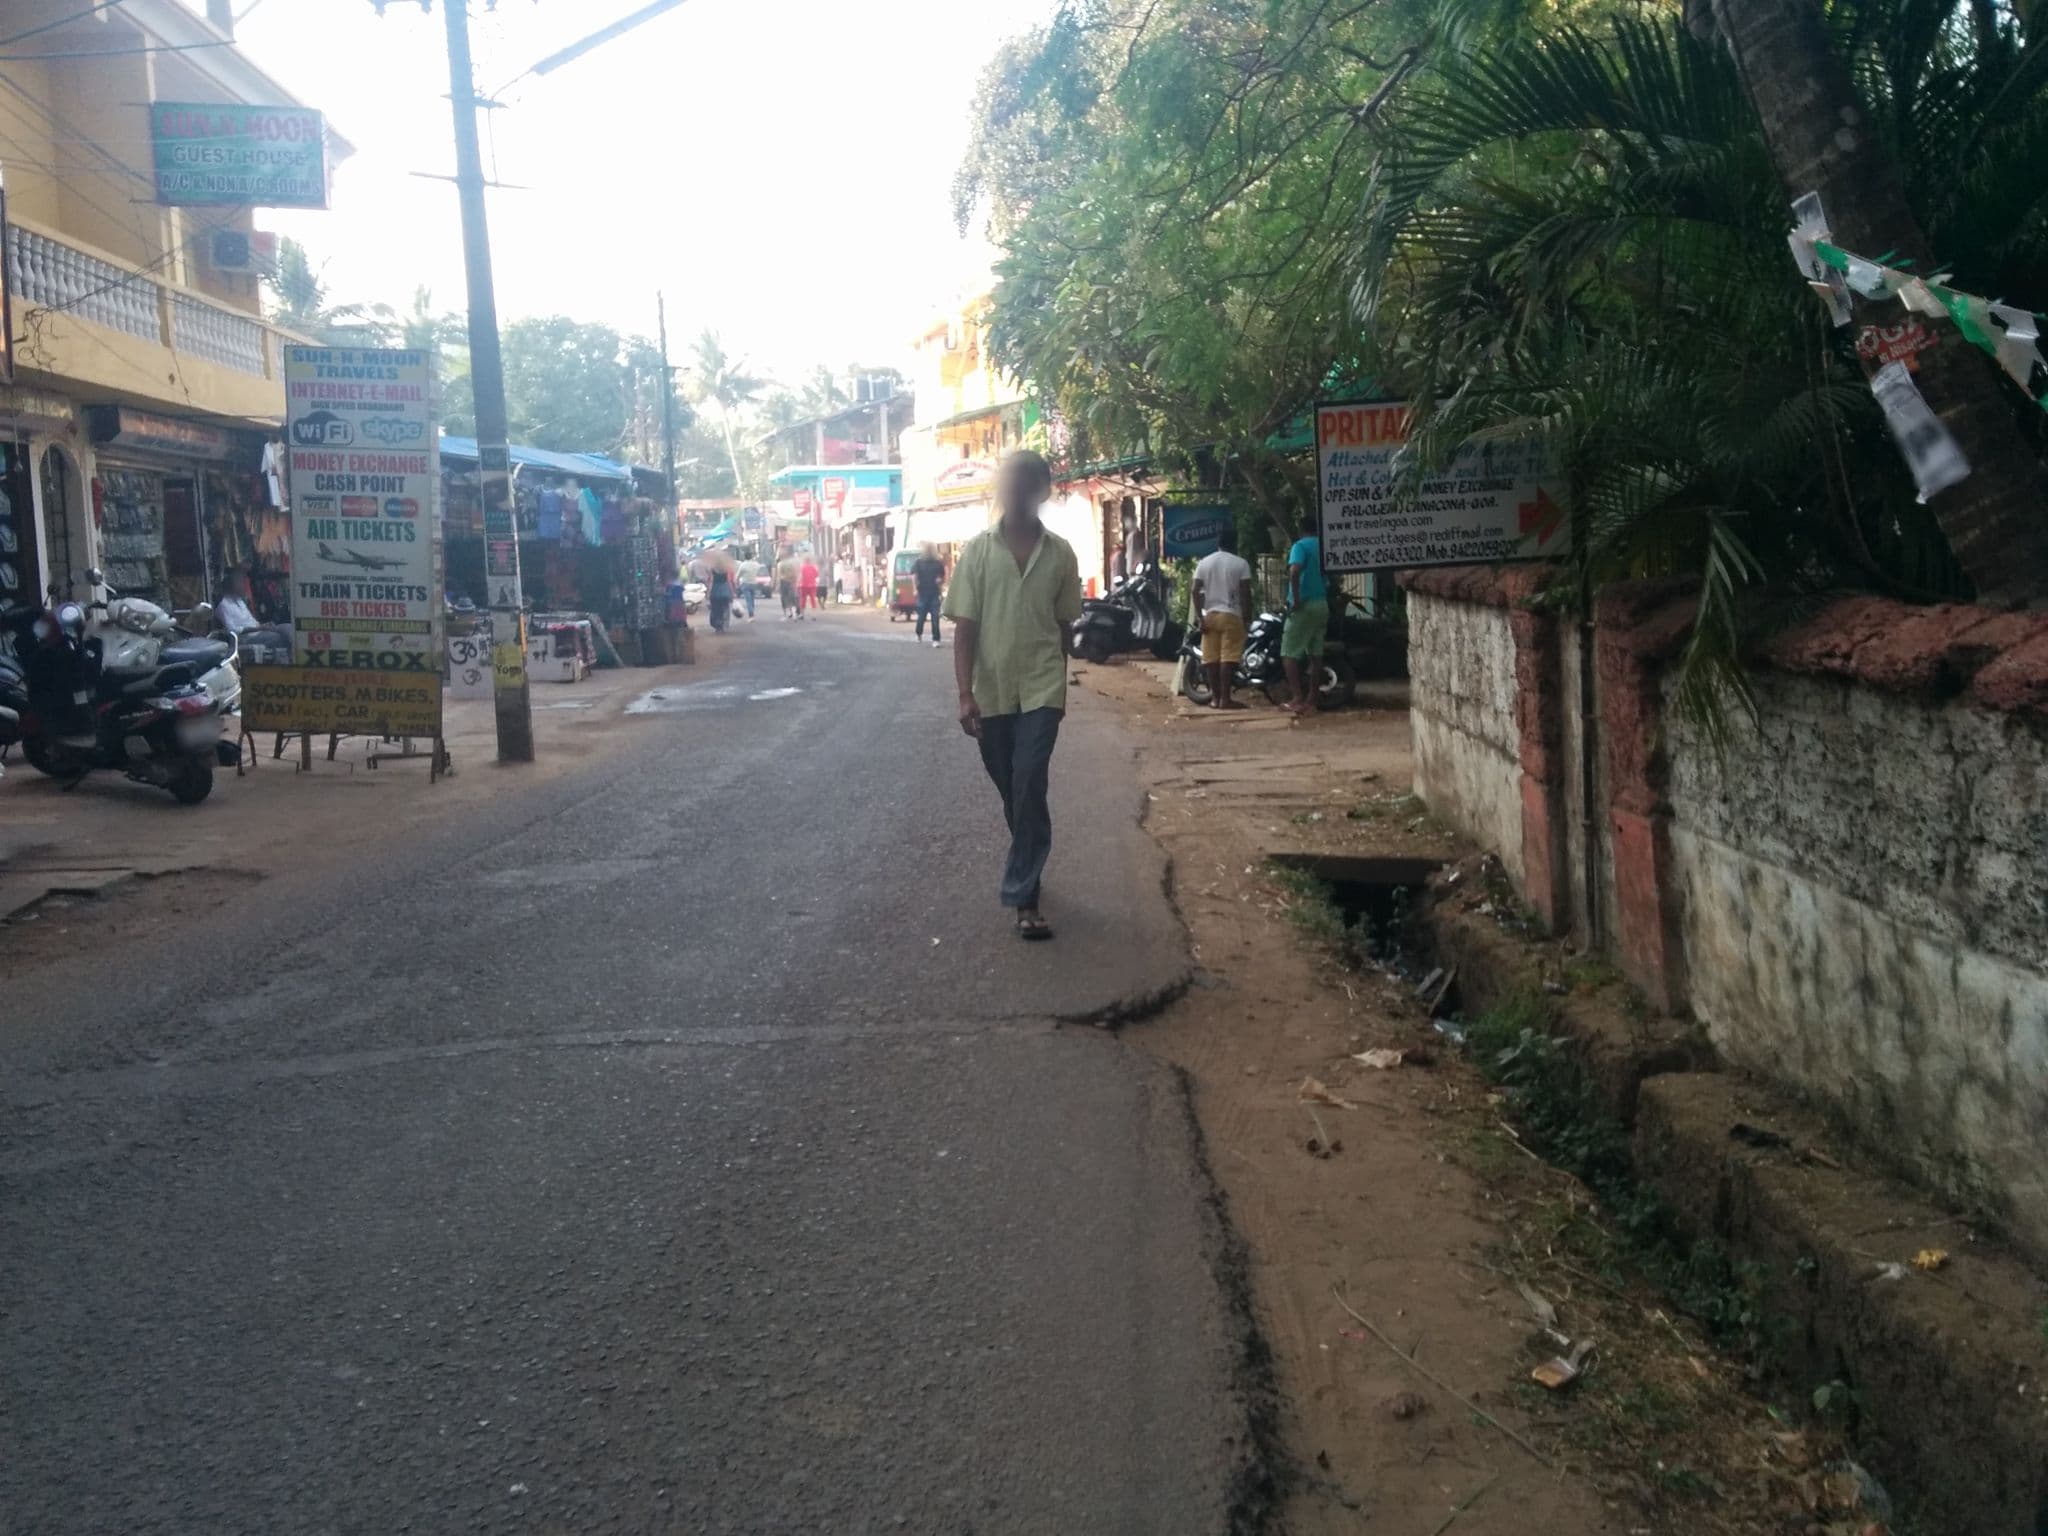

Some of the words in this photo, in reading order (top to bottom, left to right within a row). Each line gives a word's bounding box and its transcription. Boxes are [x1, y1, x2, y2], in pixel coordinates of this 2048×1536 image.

[173, 146, 235, 165] GUEST
[241, 149, 308, 168] HOUSE
[161, 173, 190, 194] A/C
[315, 365, 399, 381] TRAVELS
[293, 453, 345, 473] MONEY
[349, 455, 428, 475] EXCHANGE
[1326, 450, 1391, 468] Attached
[314, 473, 356, 493] CASH
[360, 475, 406, 494] POINT
[1327, 471, 1352, 488] Hot
[1356, 470, 1368, 485] &
[1371, 469, 1394, 485] Col
[1372, 486, 1386, 501] &
[1421, 480, 1457, 496] MONEY
[1457, 478, 1514, 494] EXCHANGE
[307, 518, 338, 541] AIR
[342, 520, 416, 543] TICKETS
[299, 582, 353, 600] TRAIN
[354, 584, 428, 602] TICKETS
[320, 601, 349, 617] BUS
[352, 602, 407, 619] TICKETS
[303, 649, 426, 671] XEROX
[254, 702, 293, 717] TAXI
[335, 704, 369, 719] CAR
